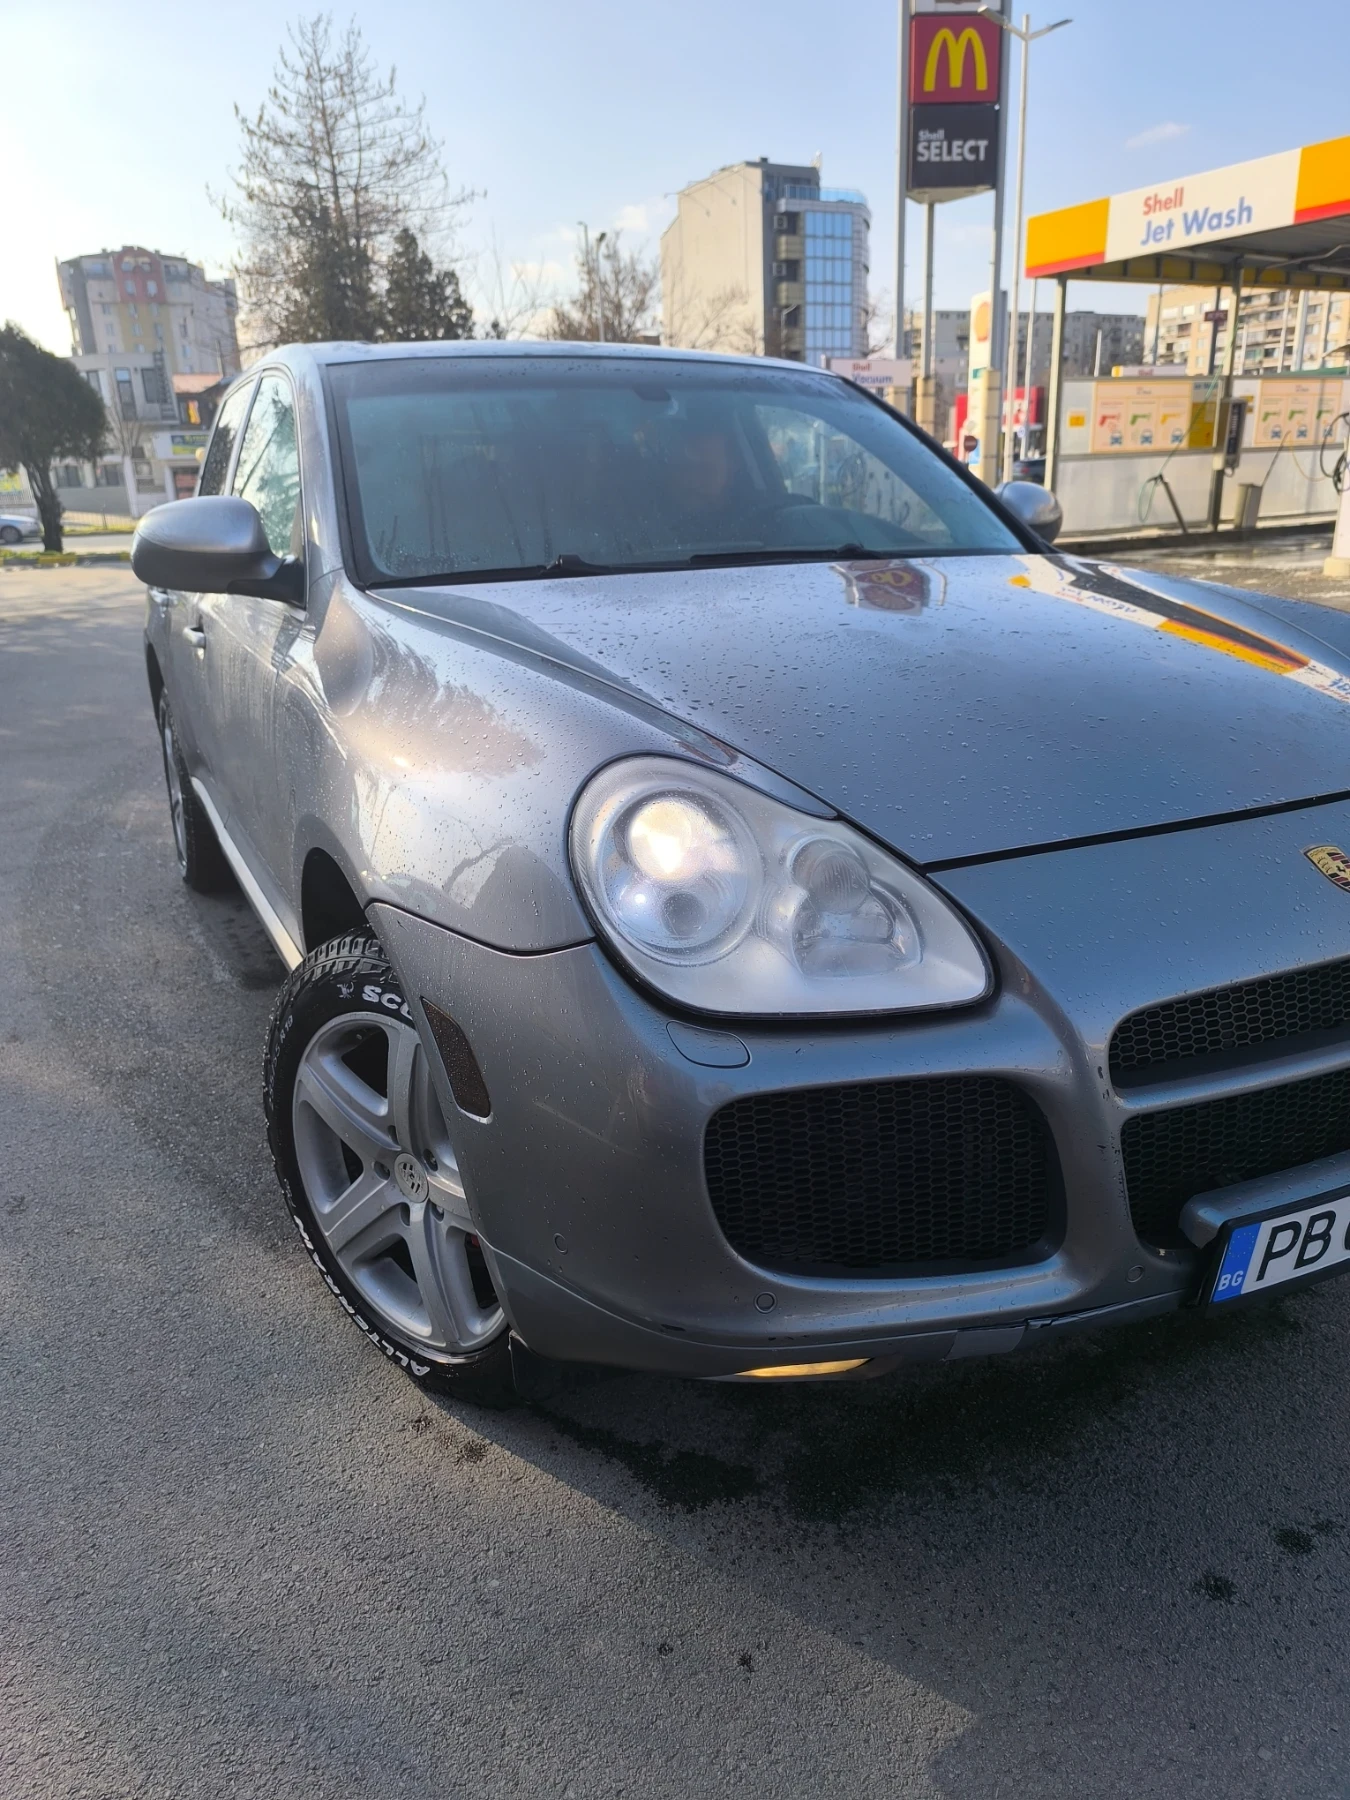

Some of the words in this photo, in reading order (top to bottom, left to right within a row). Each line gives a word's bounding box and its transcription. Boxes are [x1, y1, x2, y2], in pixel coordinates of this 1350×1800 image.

[918, 128, 945, 140] Shell
[917, 140, 989, 162] SELECT
[1143, 187, 1184, 216] Shell
[1140, 218, 1175, 247] Jet
[1182, 196, 1253, 237] Wash
[852, 374, 894, 385] Vacuum
[1255, 1209, 1337, 1283] PB
[1217, 1270, 1244, 1292] BG
